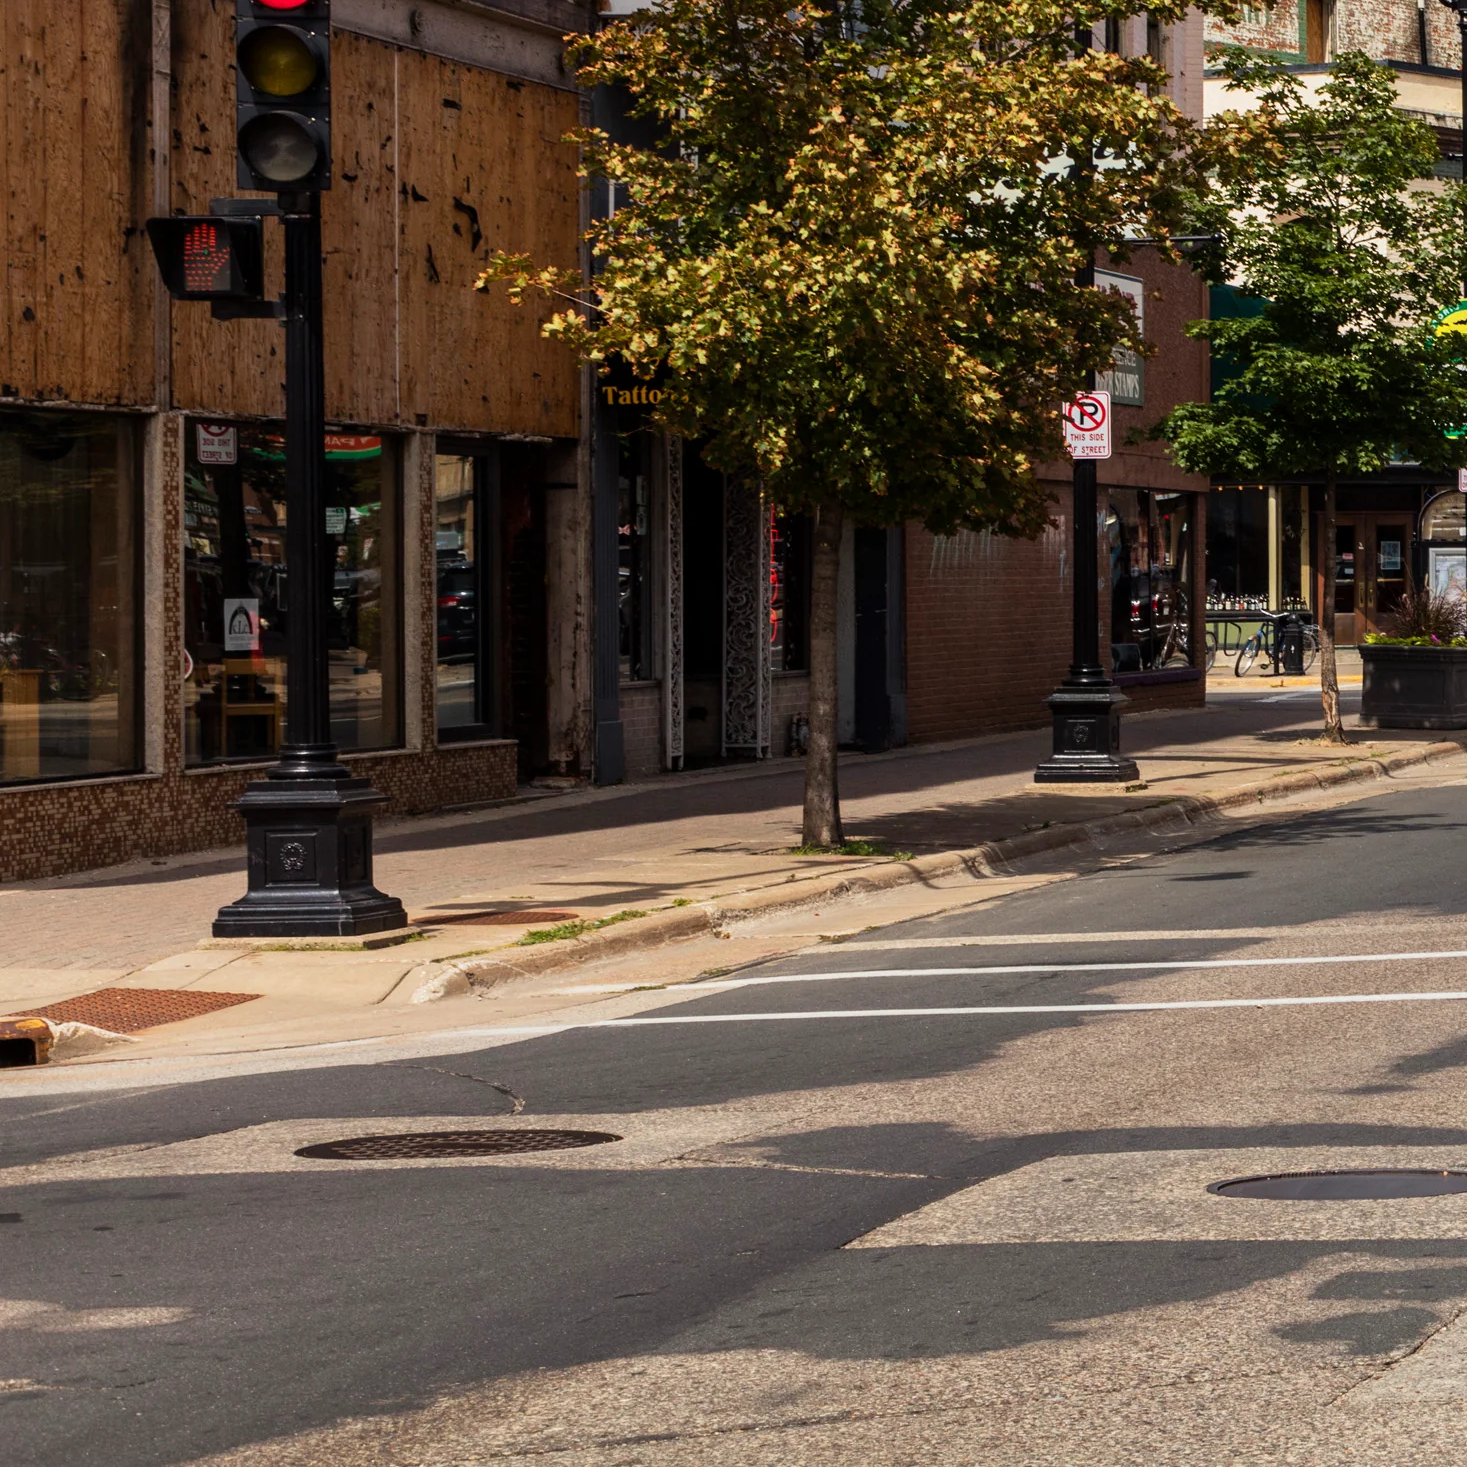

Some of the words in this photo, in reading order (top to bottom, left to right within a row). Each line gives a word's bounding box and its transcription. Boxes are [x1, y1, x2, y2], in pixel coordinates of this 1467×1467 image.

[602, 385, 690, 406] Tatto
[1070, 433, 1086, 441] THIS
[1089, 433, 1104, 441] SIDE
[1081, 445, 1106, 454] STREET
